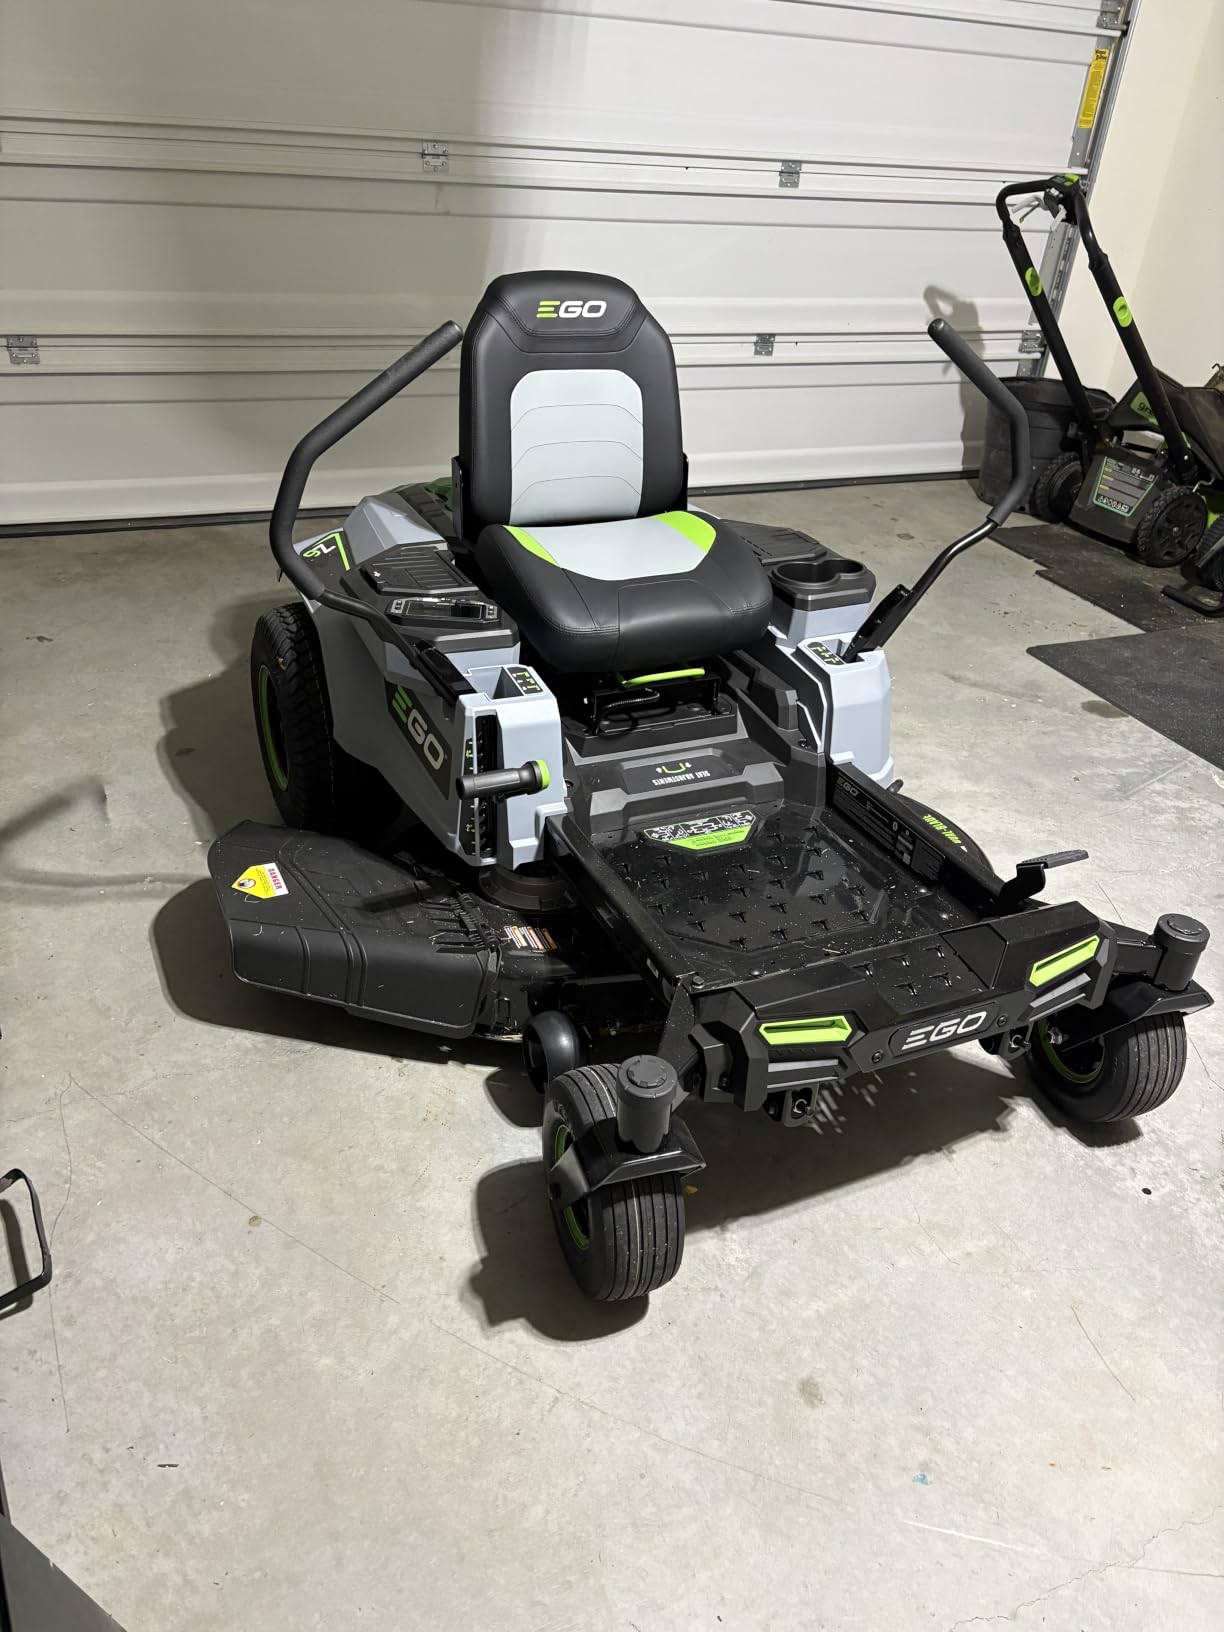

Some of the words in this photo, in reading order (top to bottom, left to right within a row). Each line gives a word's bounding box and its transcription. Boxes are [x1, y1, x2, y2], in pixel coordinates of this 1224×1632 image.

[536, 300, 607, 318] EGO
[391, 685, 445, 770] EGO
[267, 868, 283, 890] DANGER
[901, 1011, 987, 1050] EGO
